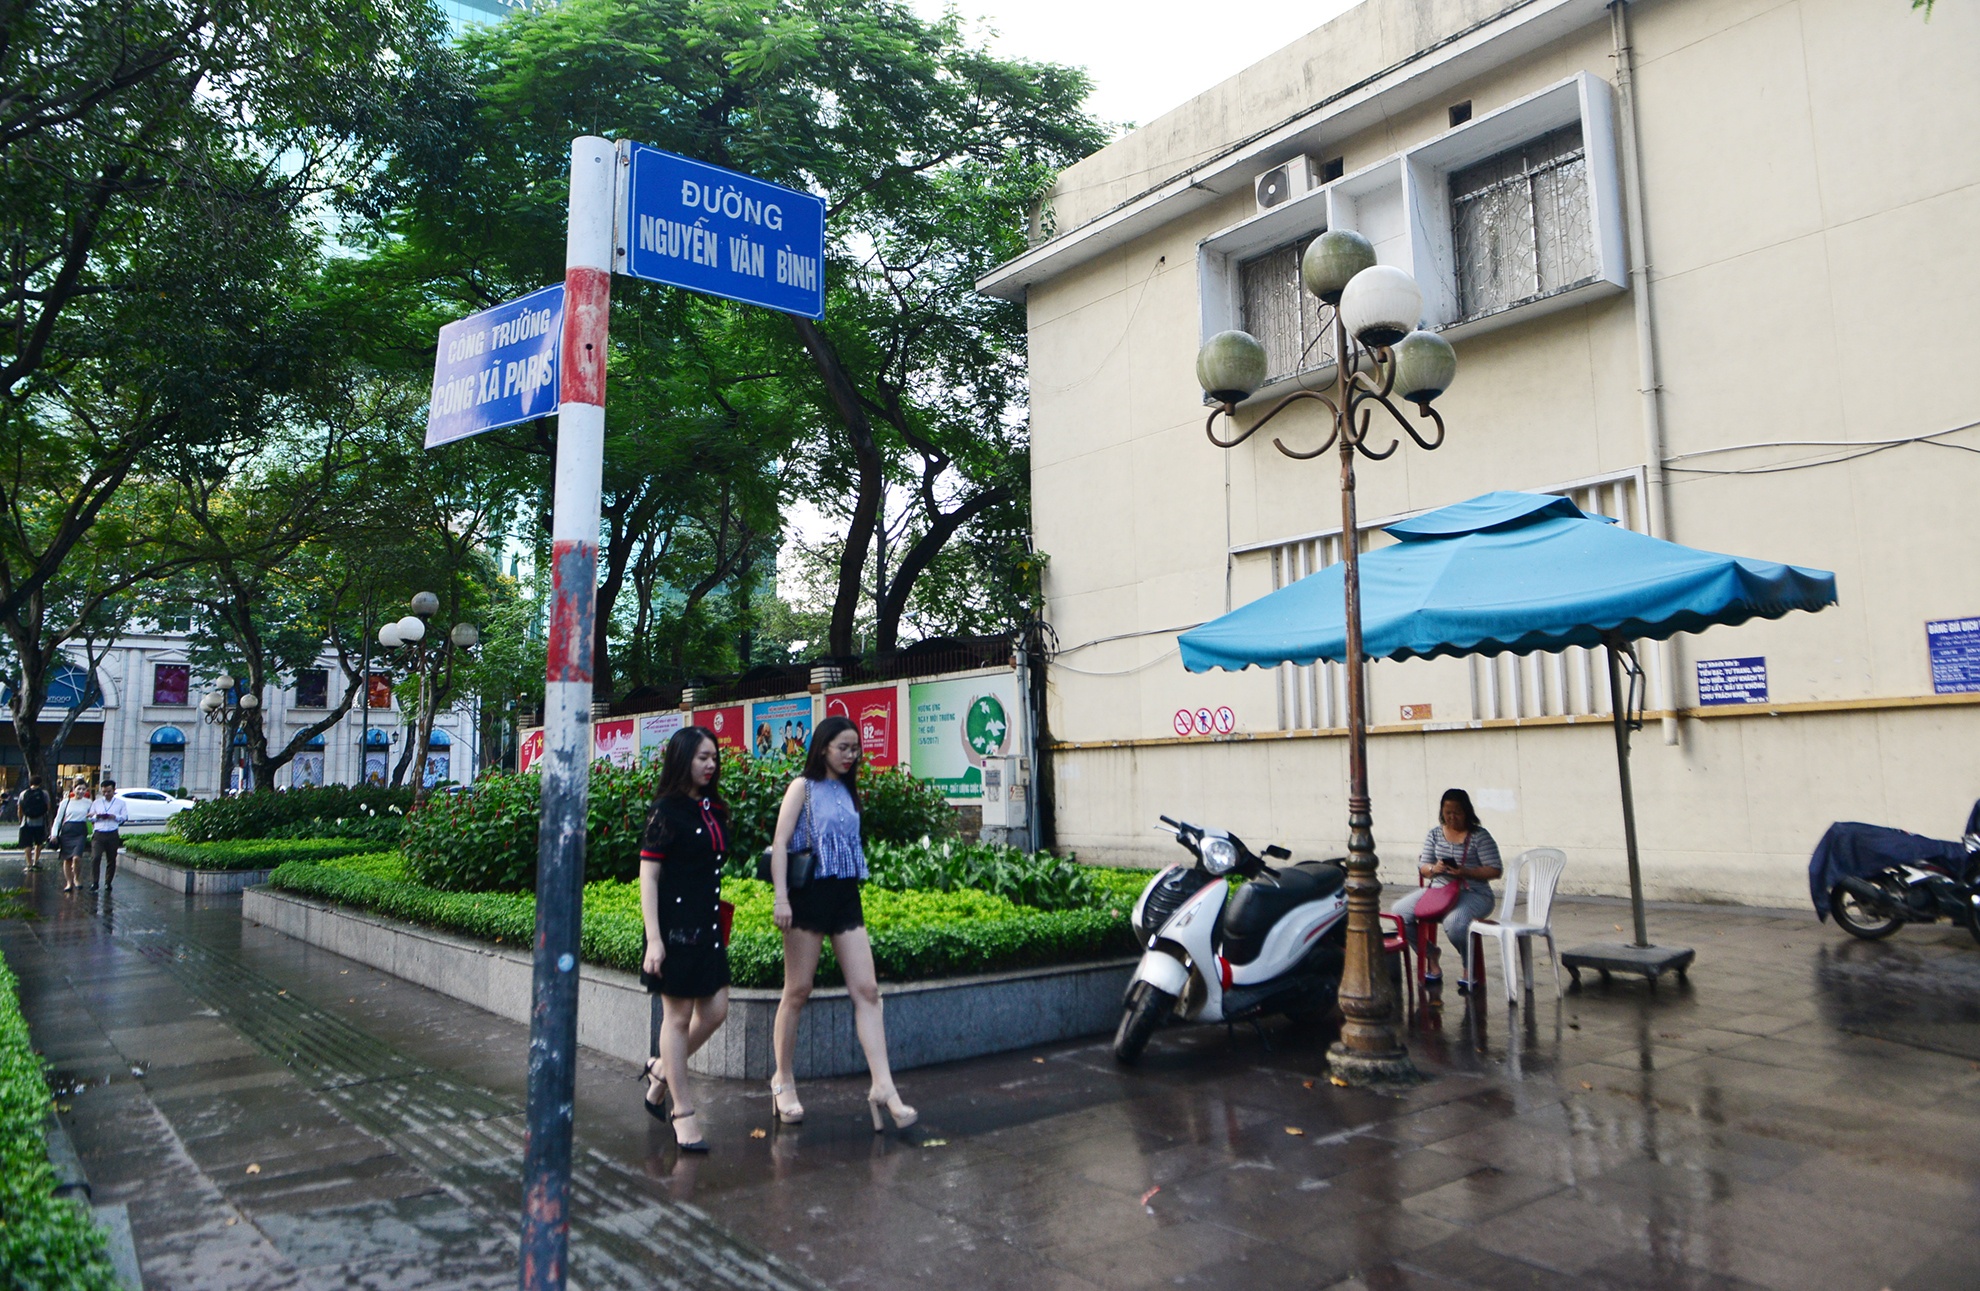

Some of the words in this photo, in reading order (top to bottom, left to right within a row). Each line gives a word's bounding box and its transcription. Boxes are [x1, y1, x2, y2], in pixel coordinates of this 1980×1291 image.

[681, 179, 783, 231] ĐƯỜNG
[639, 213, 718, 269] NGUYỄN
[729, 233, 765, 279] VĂN
[776, 244, 817, 292] BÌNH
[447, 330, 485, 365] CÔNG
[491, 307, 551, 351] TRƯỜNG
[432, 374, 475, 420] CÔNG
[475, 359, 502, 406] XÃ
[503, 348, 554, 399] PARIS
[863, 725, 875, 739] 92
